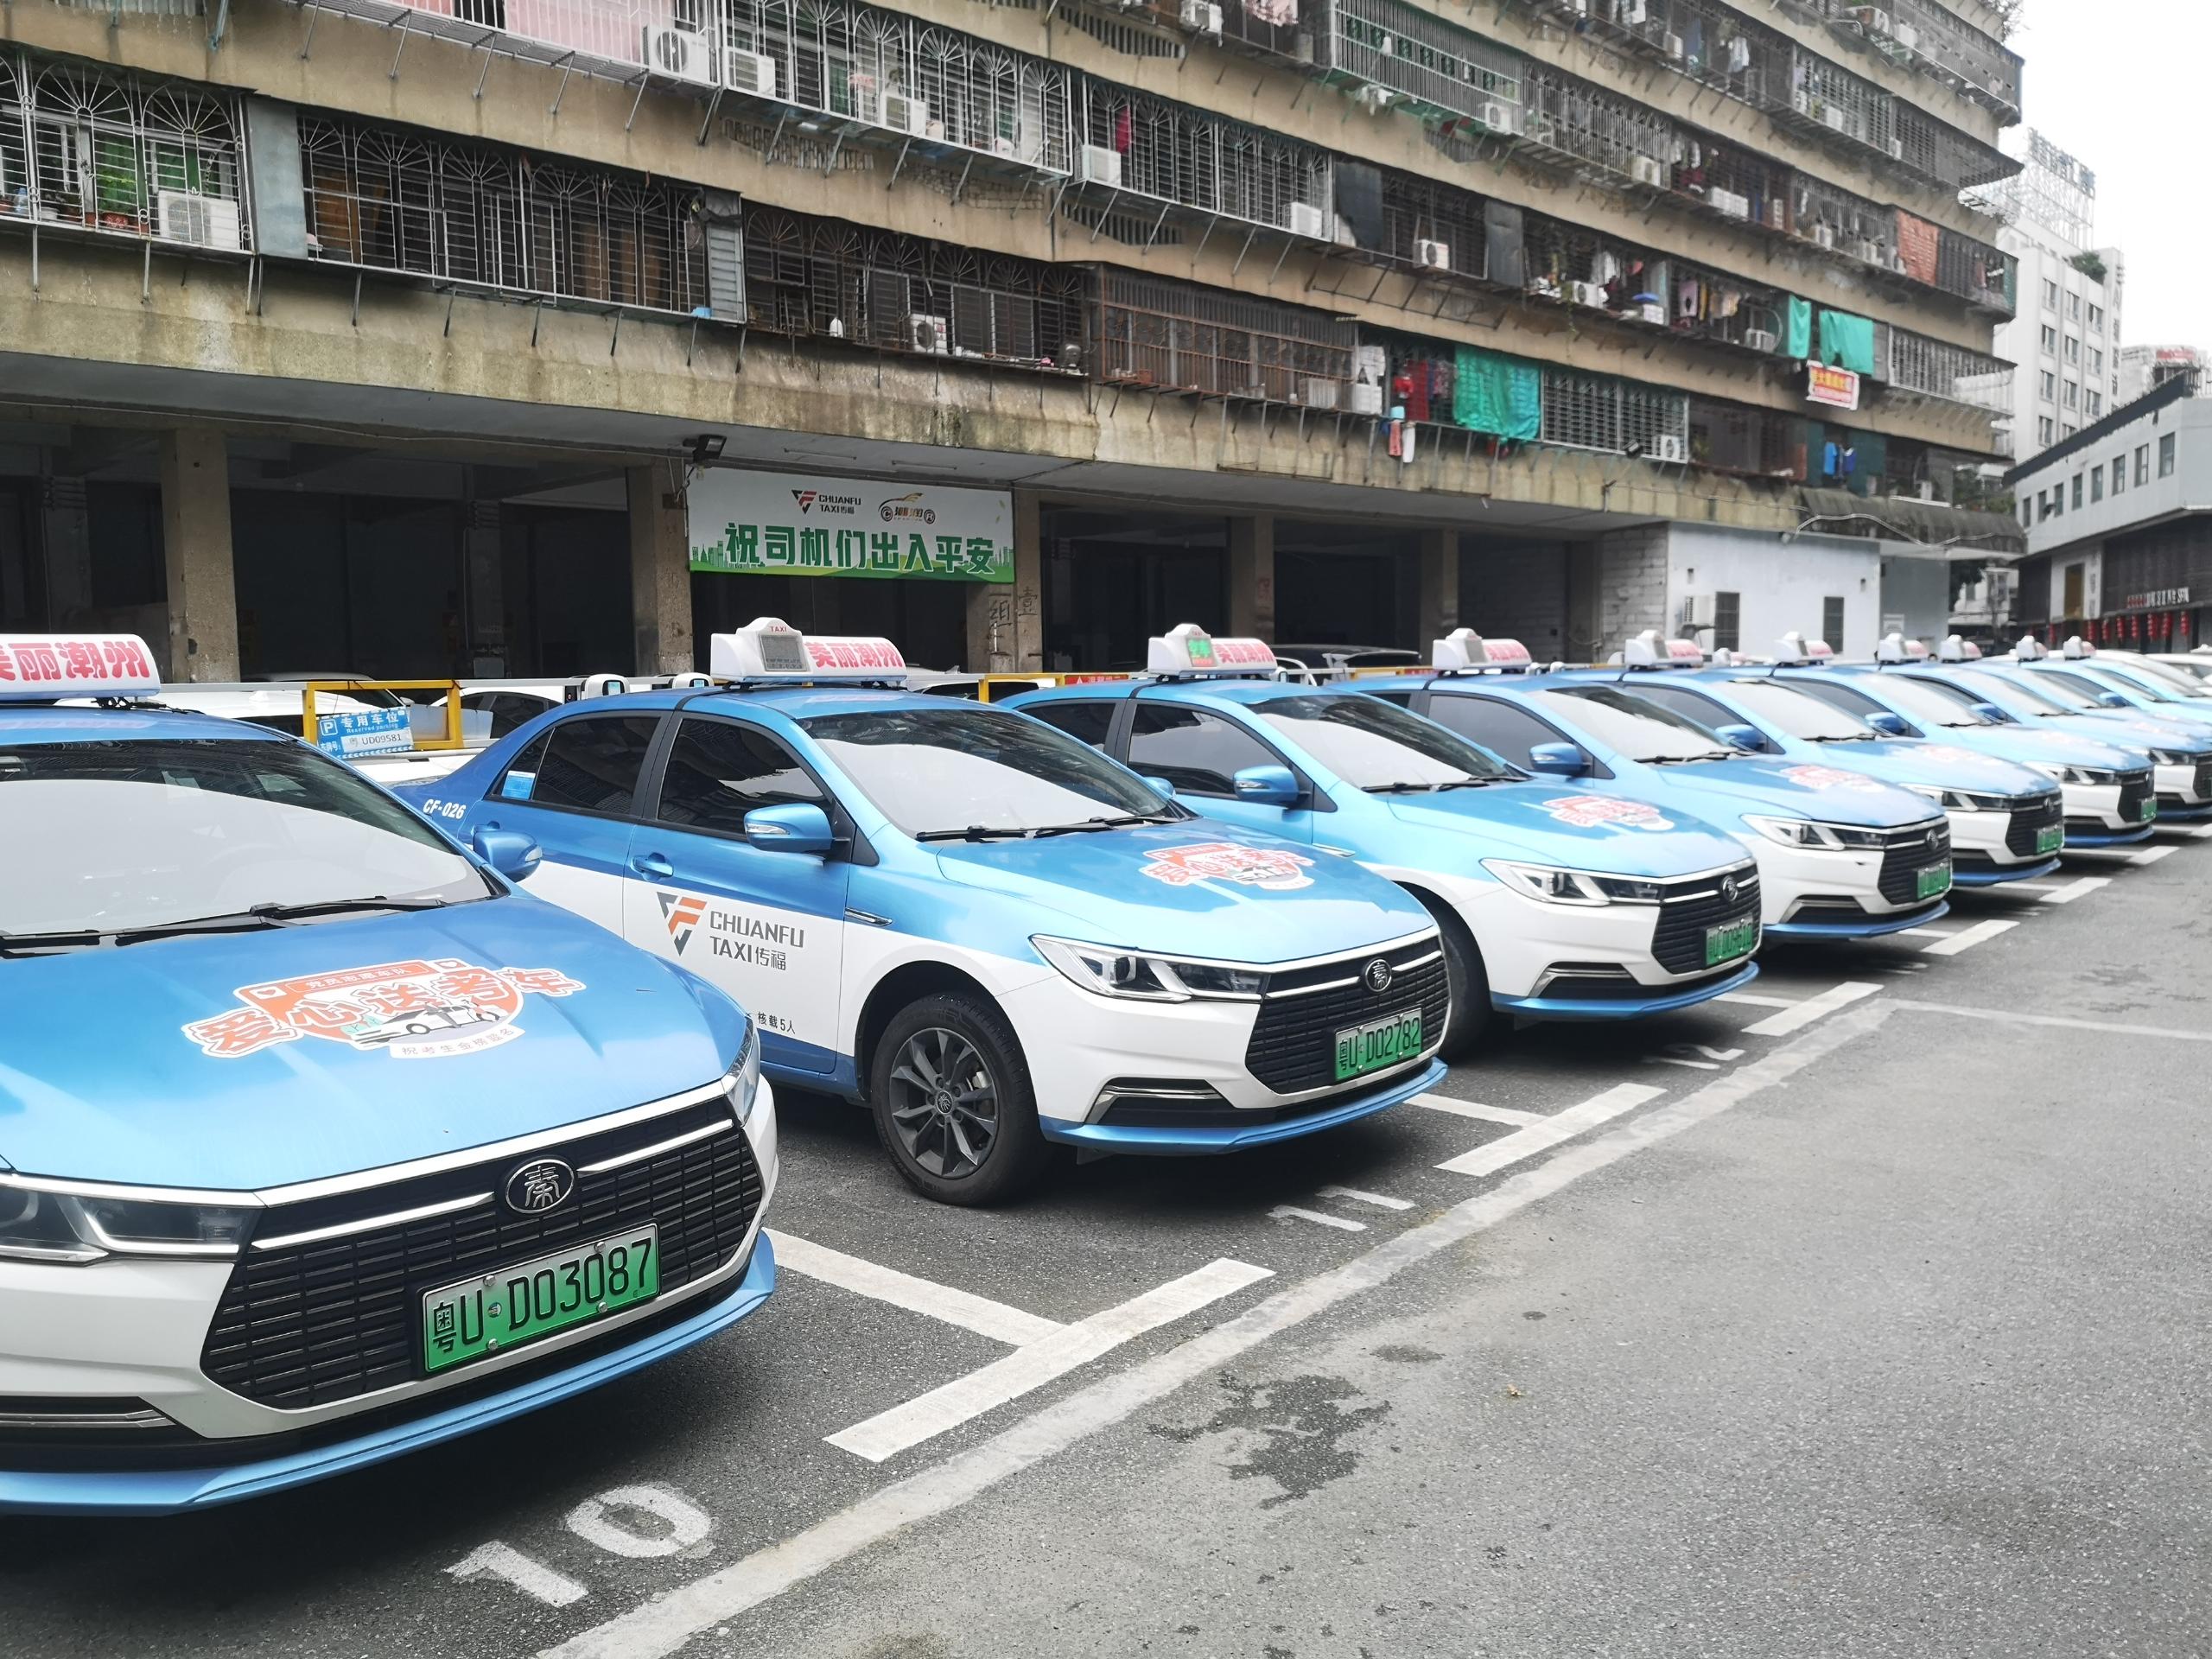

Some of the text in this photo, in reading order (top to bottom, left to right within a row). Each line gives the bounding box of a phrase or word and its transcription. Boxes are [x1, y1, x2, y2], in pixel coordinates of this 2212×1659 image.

[818, 494, 861, 505] CHUANFU
[725, 522, 995, 575] 祝司机们出入平安
[804, 642, 903, 668] 美丽潮州
[340, 712, 399, 728] 专用车位
[423, 798, 467, 820] CF-026
[709, 910, 804, 949] CHUANFU
[709, 936, 787, 971] TAXI 传福
[187, 969, 582, 1054] 爱心送考车
[757, 1011, 796, 1034] 核载5人
[442, 1481, 714, 1608] 10
